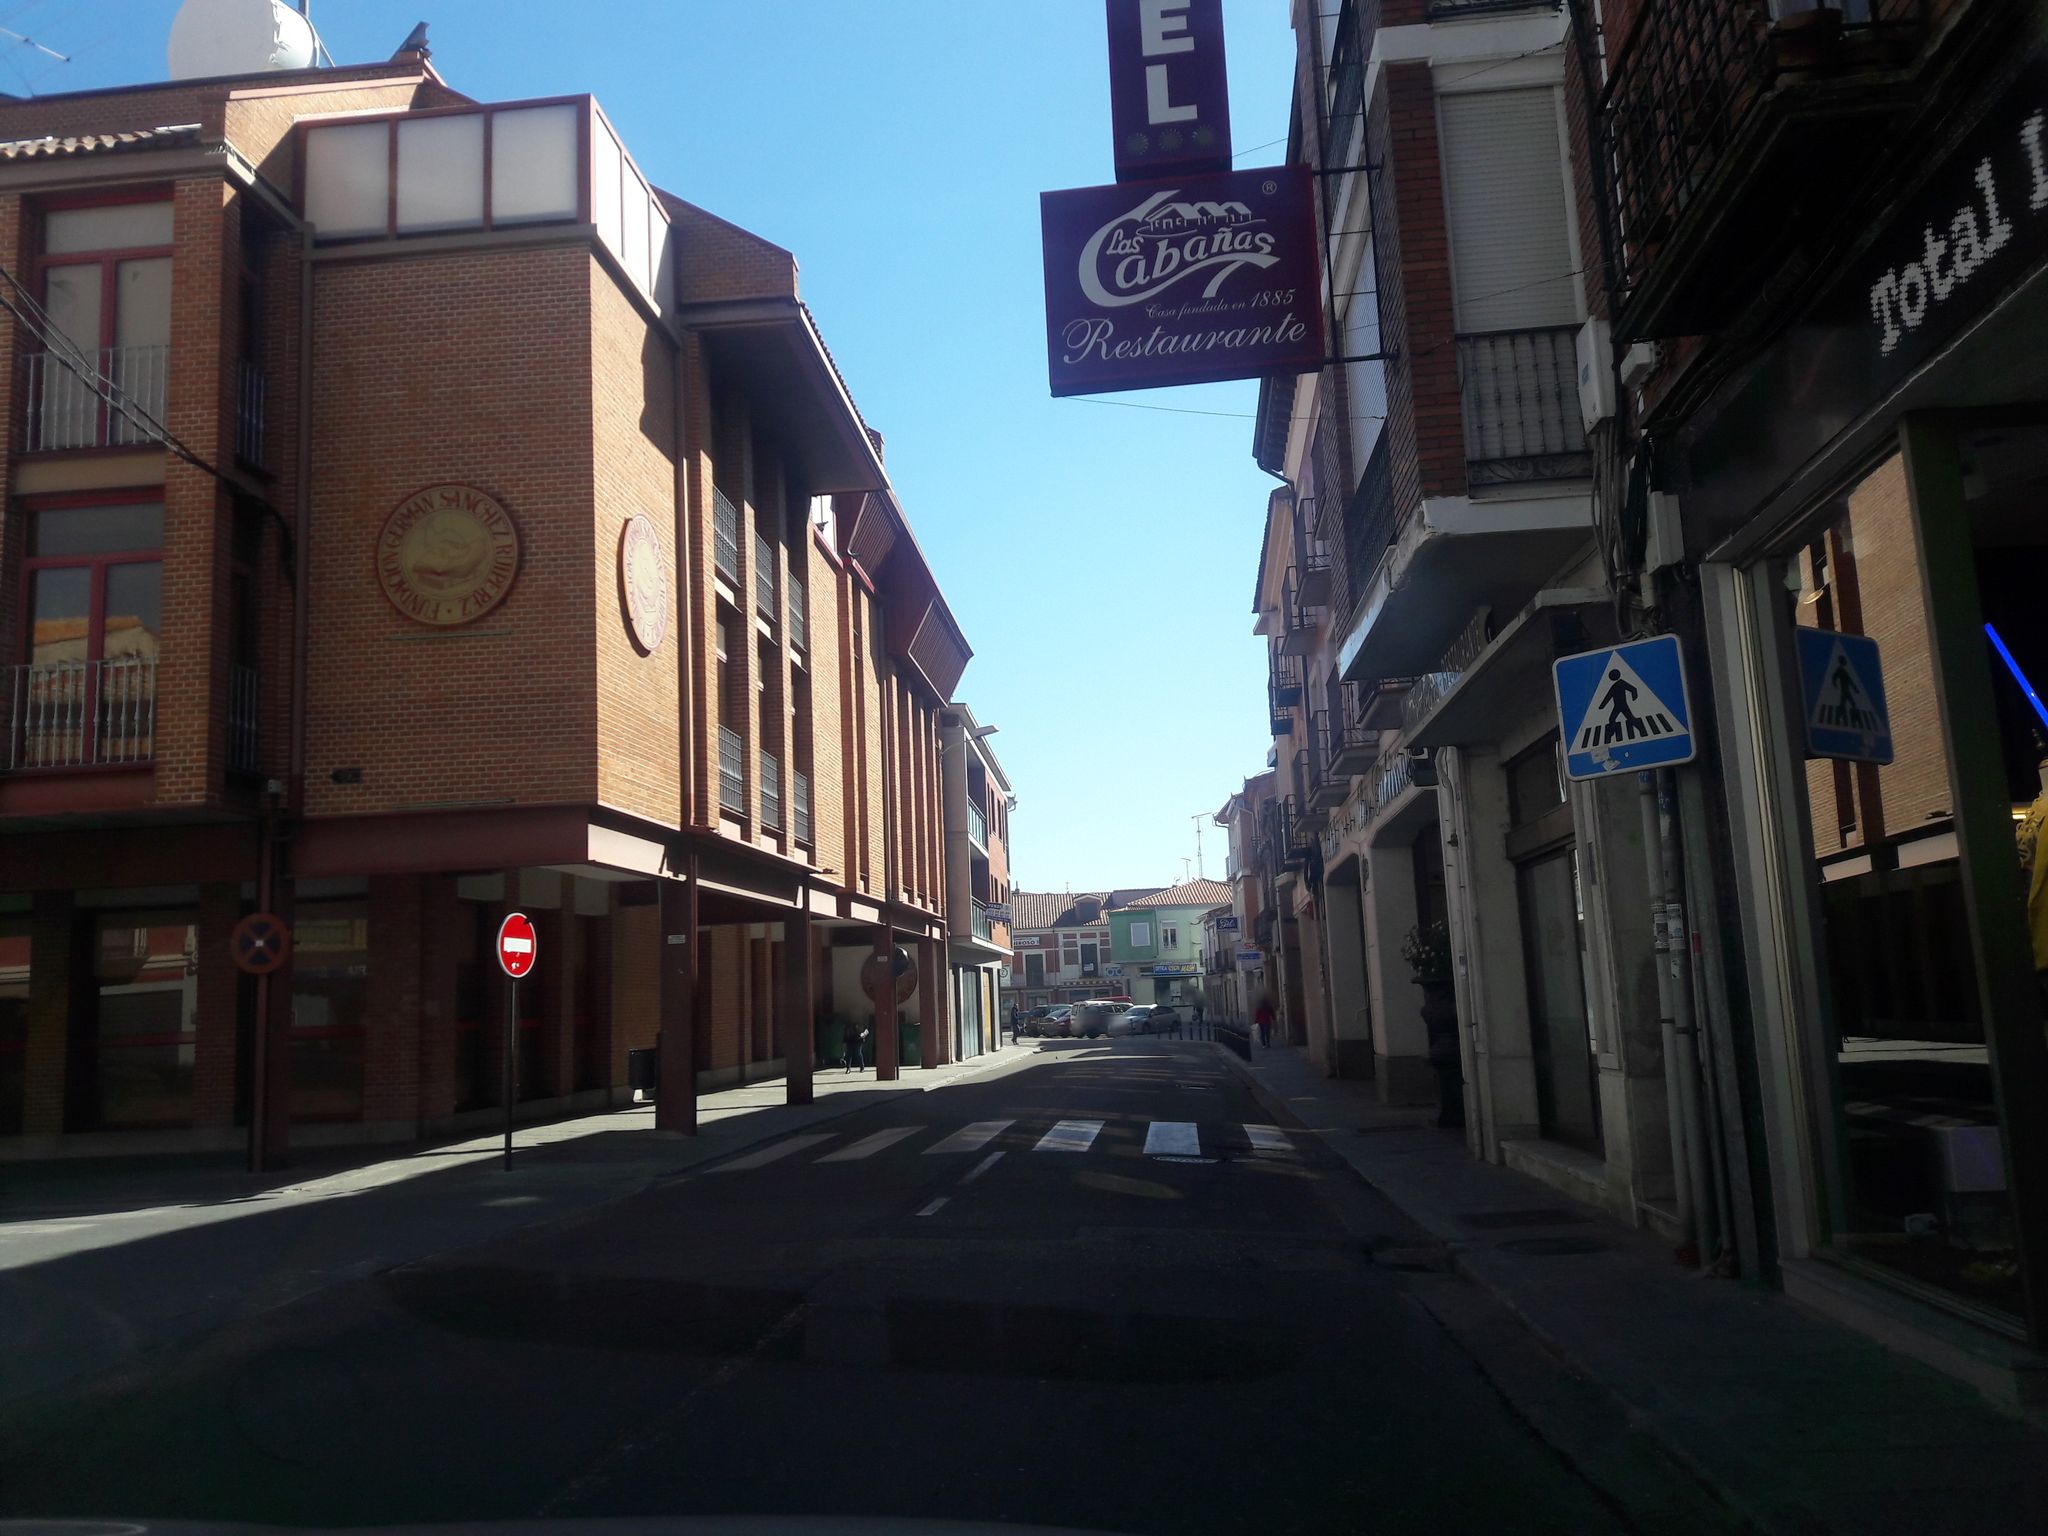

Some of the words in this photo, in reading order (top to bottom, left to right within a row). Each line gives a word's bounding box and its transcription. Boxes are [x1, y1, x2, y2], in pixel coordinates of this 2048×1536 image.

[1870, 157, 2013, 356] Total
[1146, 303, 1176, 319] Casa
[1178, 298, 1228, 321] fundada
[1231, 302, 1246, 310] en
[1250, 288, 1297, 309] 1885
[1062, 313, 1307, 364] Restaurante
